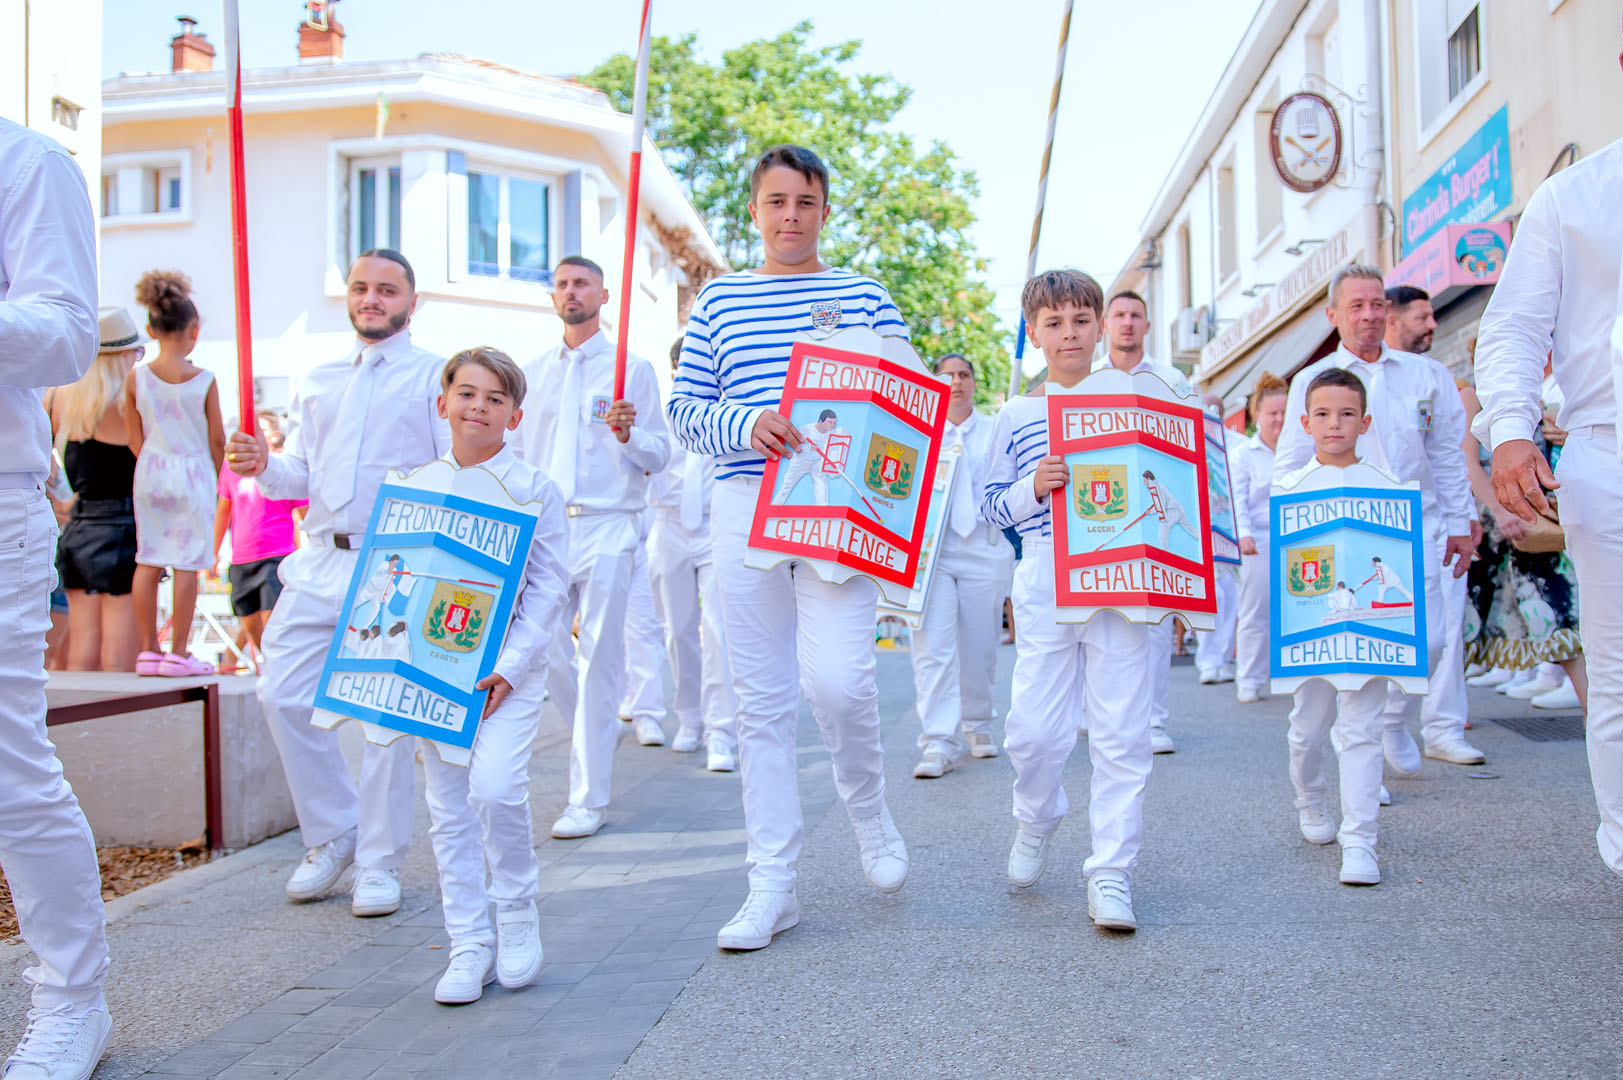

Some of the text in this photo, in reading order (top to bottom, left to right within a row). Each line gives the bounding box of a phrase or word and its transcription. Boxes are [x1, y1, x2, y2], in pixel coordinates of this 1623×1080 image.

[1407, 184, 1449, 243] Clarinda
[1451, 152, 1491, 208] Burger
[1279, 230, 1348, 309] CHOCOLATIER
[802, 360, 936, 428] FRONTIGNAN
[1065, 411, 1189, 449] FRONTIGNAN
[382, 501, 517, 562] FRONTIGNAN
[1283, 500, 1408, 534] FRONTIGNAN
[775, 519, 897, 568] CHALLENGE
[1080, 561, 1194, 597] CHALLENGE
[1290, 635, 1406, 664] CHALLENGE
[338, 675, 458, 726] CHALLENGE
